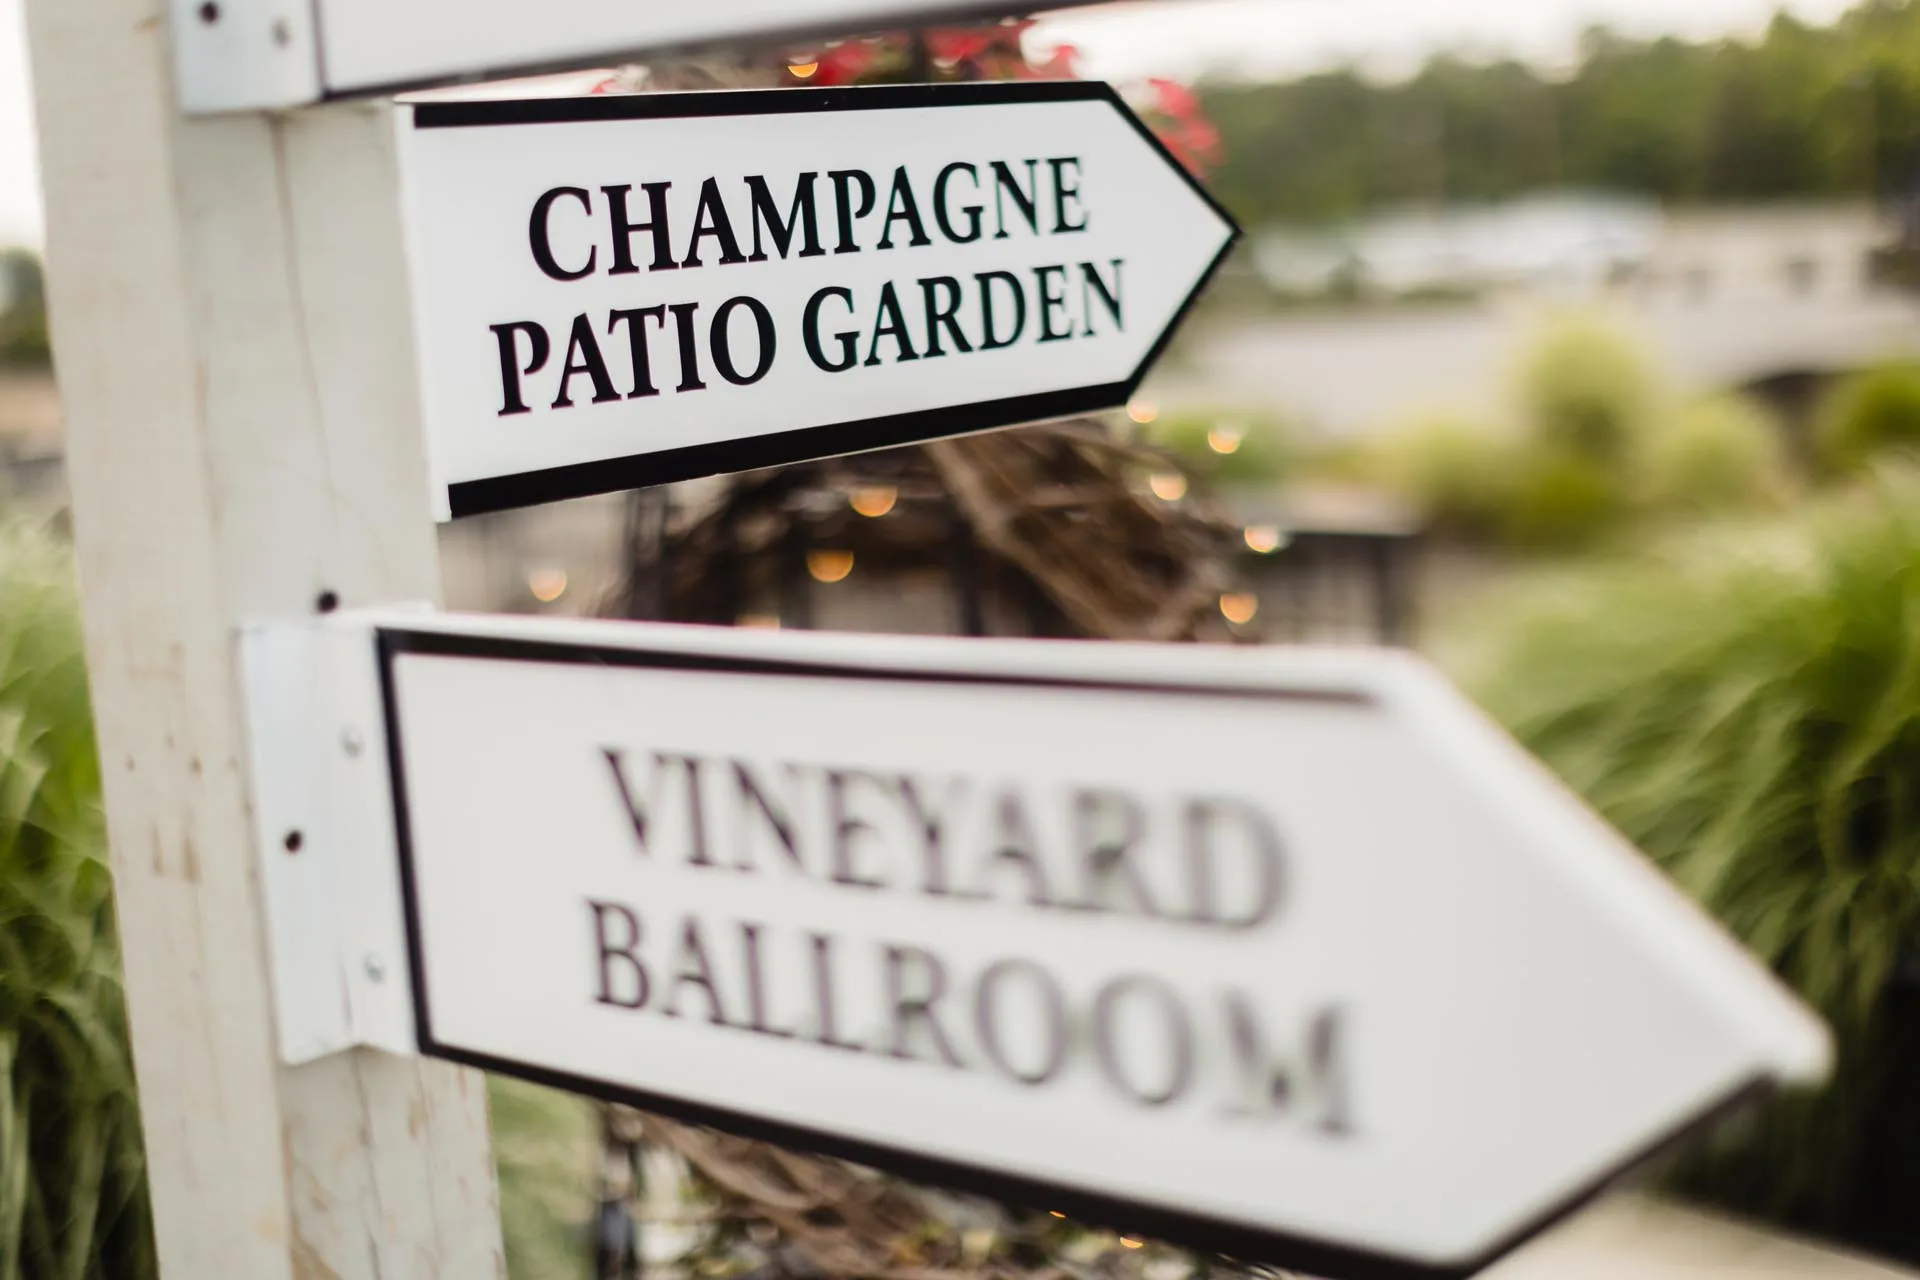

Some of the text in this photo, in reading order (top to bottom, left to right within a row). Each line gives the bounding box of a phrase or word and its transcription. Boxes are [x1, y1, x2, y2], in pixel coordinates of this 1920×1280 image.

[528, 156, 1087, 282] CHAMPAGNE
[489, 258, 1125, 416] PATIO GARDEN
[599, 747, 1289, 932] VINEYARD
[583, 897, 1357, 1138] BALLROOM
